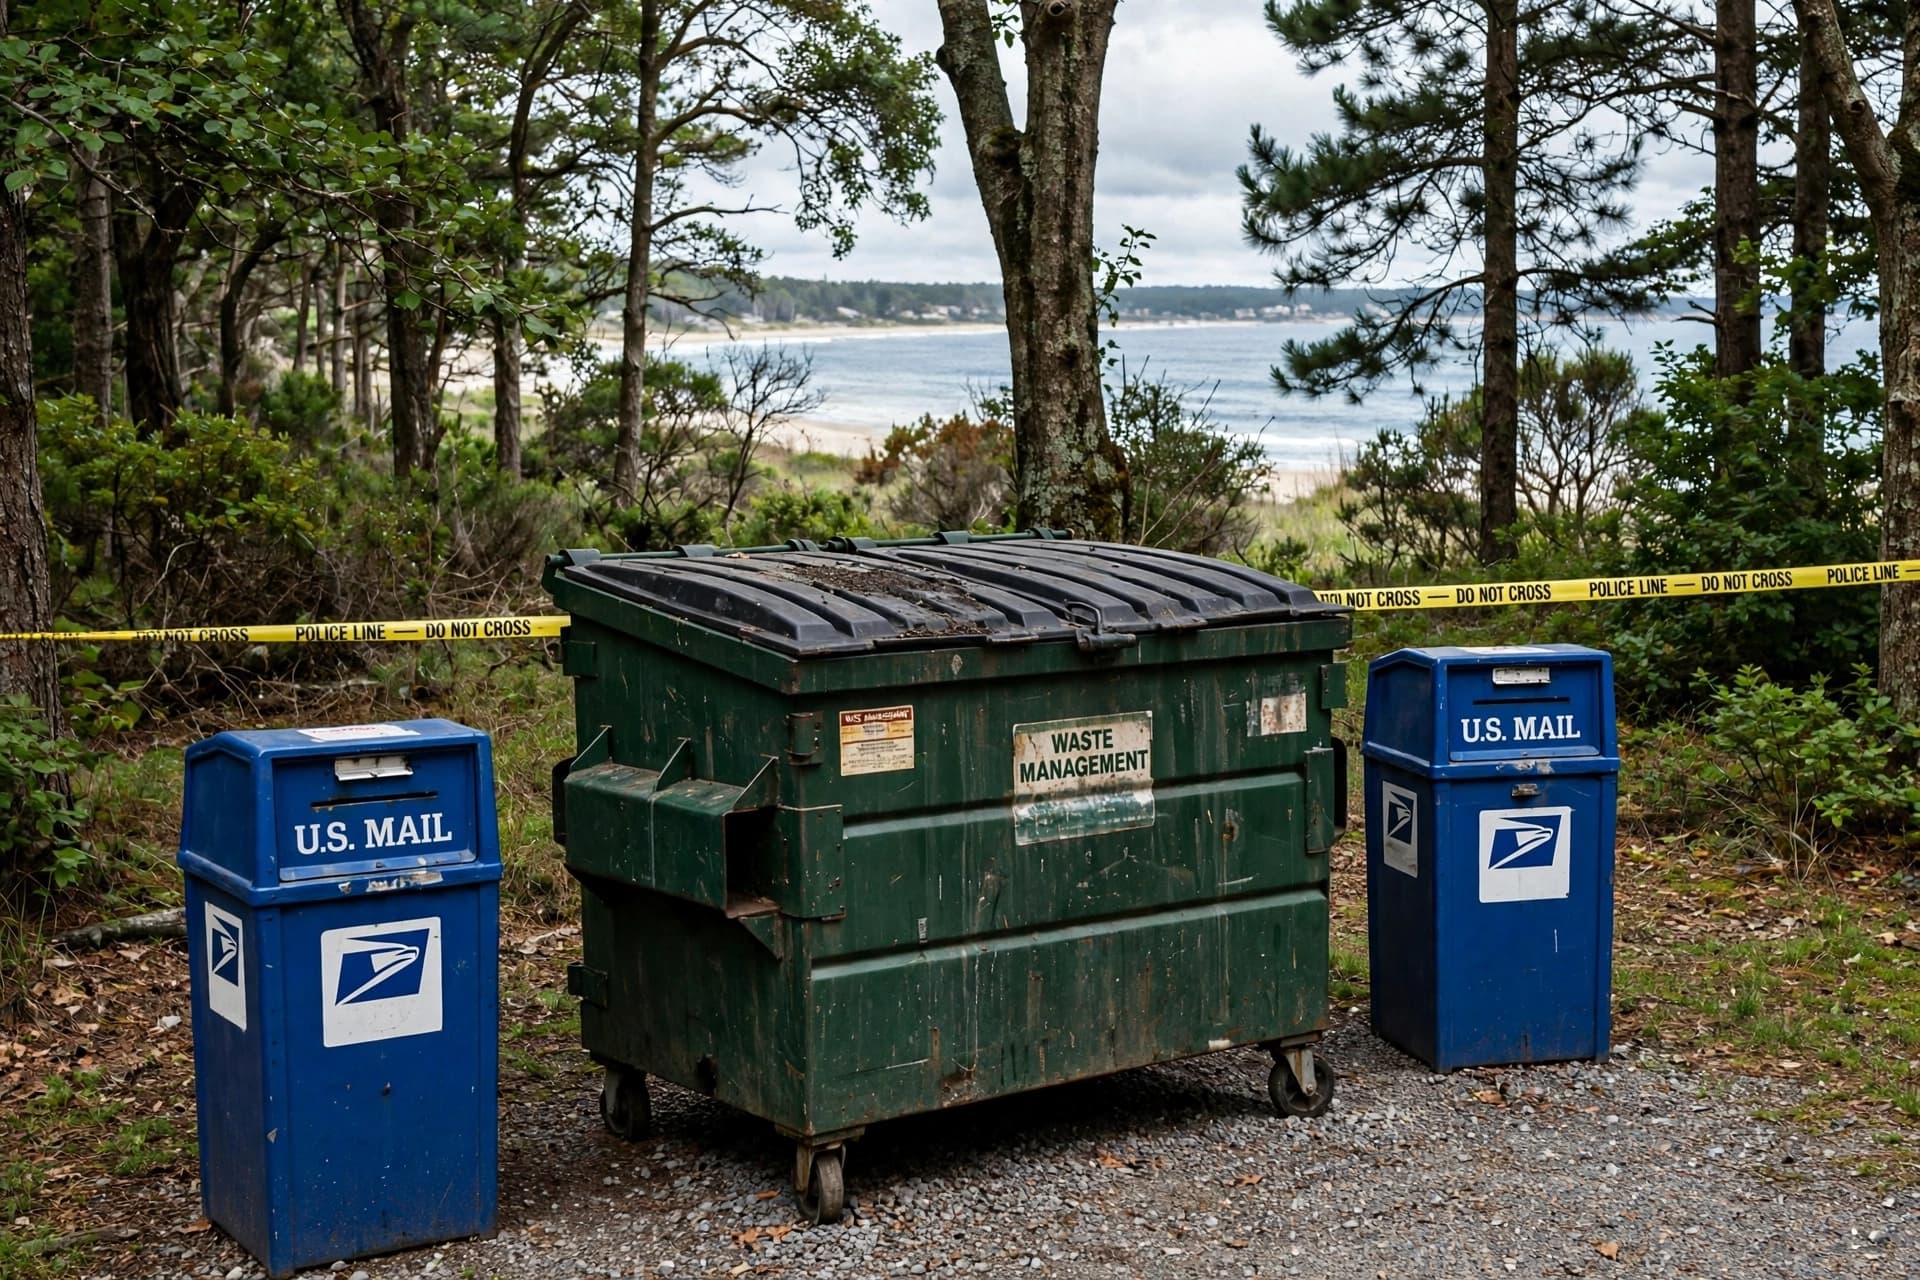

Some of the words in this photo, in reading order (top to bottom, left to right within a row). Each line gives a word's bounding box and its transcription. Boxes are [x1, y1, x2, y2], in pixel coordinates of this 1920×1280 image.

[1589, 580, 1635, 598] POLICE
[1639, 578, 1668, 595] LINE
[1701, 575, 1720, 592] DO
[1723, 573, 1750, 590] NOT
[1752, 571, 1793, 589] CROSS
[1827, 566, 1870, 584] POLICE
[1873, 564, 1900, 581] LINE
[1346, 592, 1372, 608] NOT
[1377, 590, 1421, 607] CROSS
[1456, 587, 1475, 603] DO
[1479, 586, 1507, 602] NOT
[1508, 584, 1551, 600] CROSS
[199, 628, 249, 641] CROSS
[295, 625, 348, 641] POLICE
[353, 624, 386, 640] LINE
[425, 622, 445, 638] DO
[451, 621, 479, 637] NOT
[484, 619, 531, 636] CROSS
[1051, 728, 1114, 753] WASTE
[1460, 717, 1507, 743] U.S.
[1513, 715, 1581, 741] MAIL
[1020, 749, 1148, 783] MANAGEMENT
[294, 821, 355, 855] U.S.
[363, 812, 453, 848] MAIL
